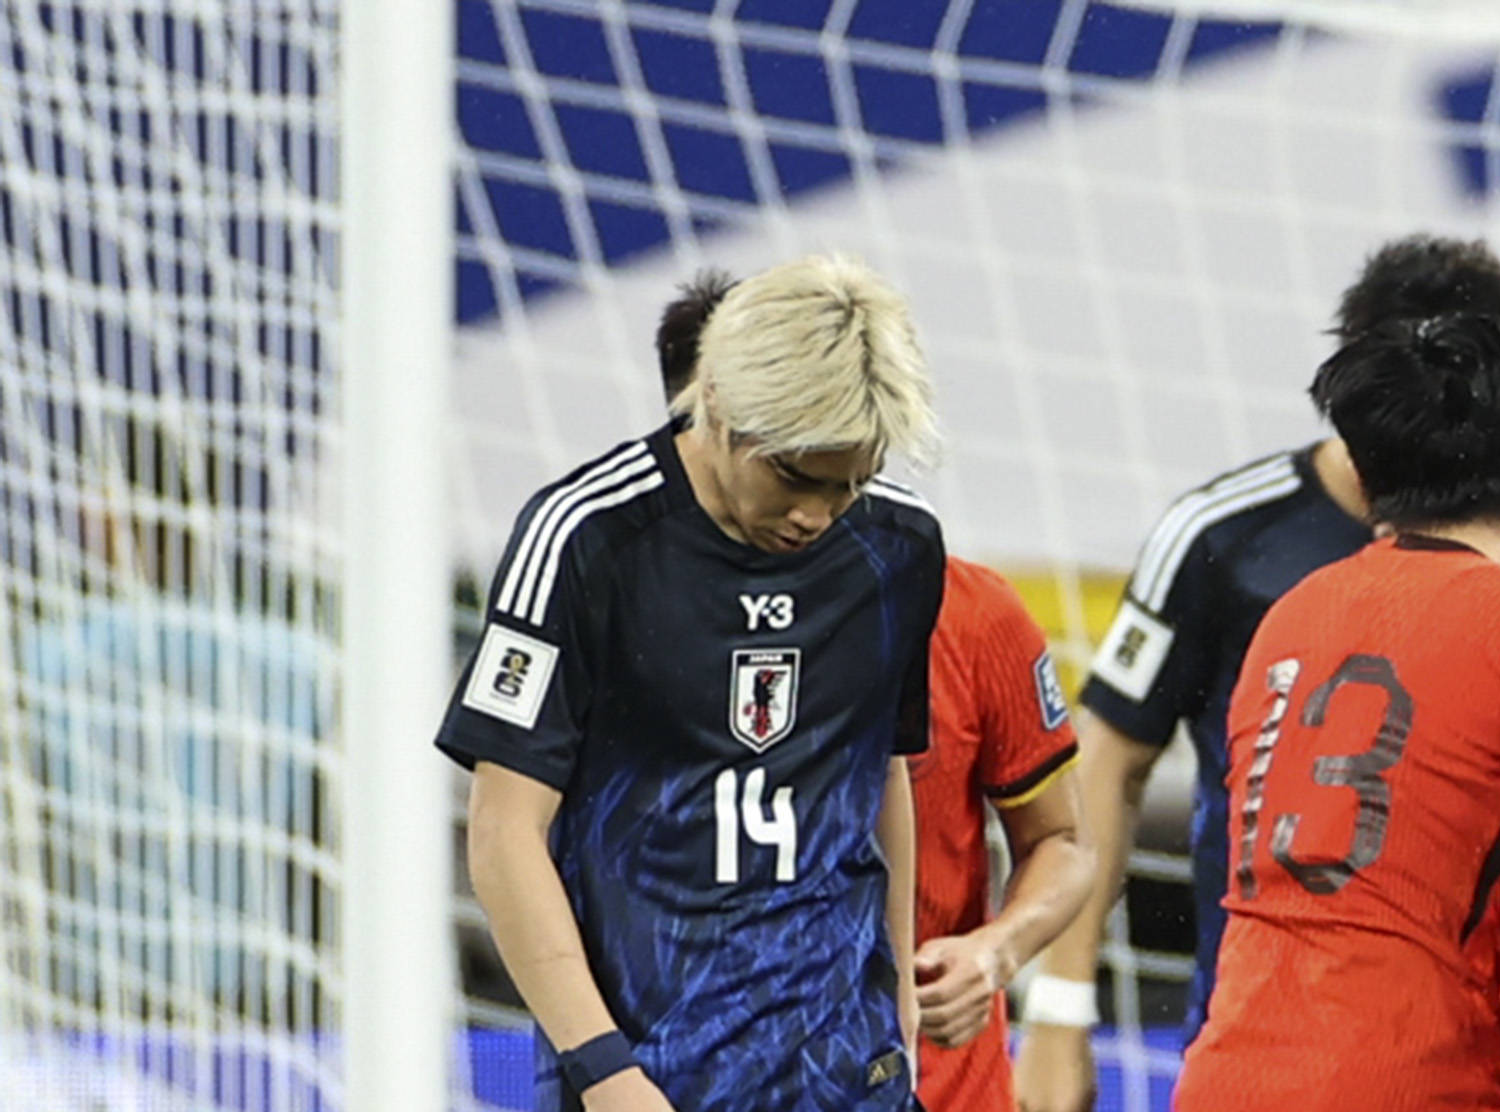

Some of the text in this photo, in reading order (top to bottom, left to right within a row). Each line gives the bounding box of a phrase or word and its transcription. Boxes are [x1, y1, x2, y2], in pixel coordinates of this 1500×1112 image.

[739, 593, 794, 631] Y-3
[715, 766, 797, 882] 14
[1237, 653, 1415, 899] 13
